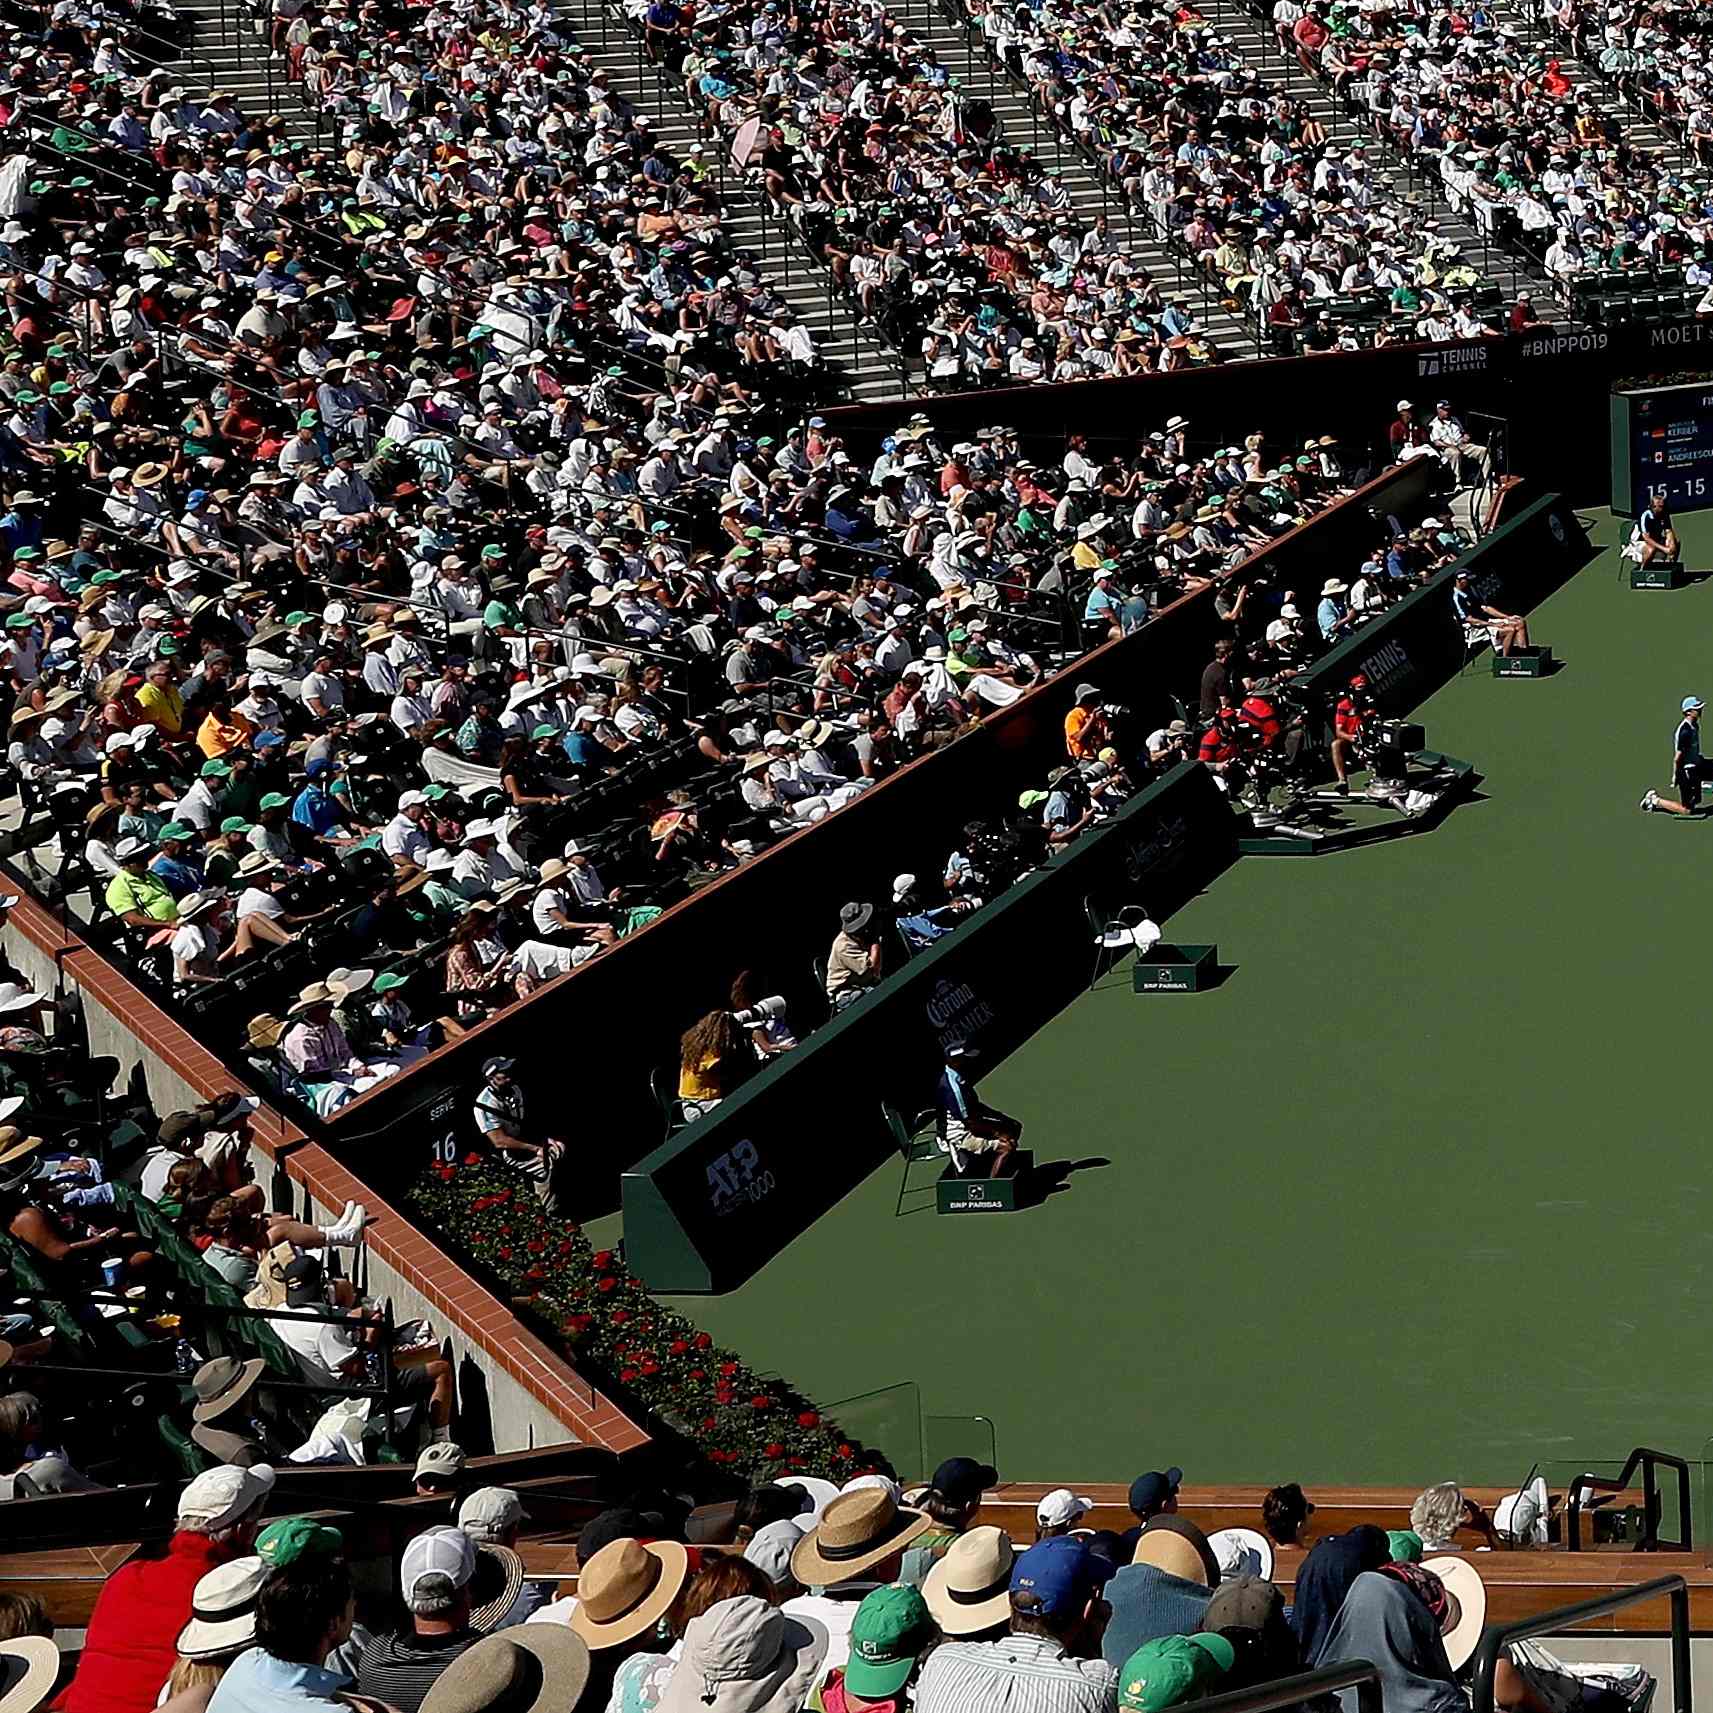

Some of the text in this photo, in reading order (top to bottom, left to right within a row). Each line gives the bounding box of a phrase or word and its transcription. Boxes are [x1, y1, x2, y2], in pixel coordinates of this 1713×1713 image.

[1441, 346, 1488, 365] TENNIS
[1521, 333, 1609, 357] #BNPPO19
[1685, 478, 1705, 497] 15
[1359, 639, 1408, 685] TENNIS
[926, 983, 975, 1030] Corona
[429, 1098, 455, 1121] SERVE
[431, 1131, 457, 1162] 16
